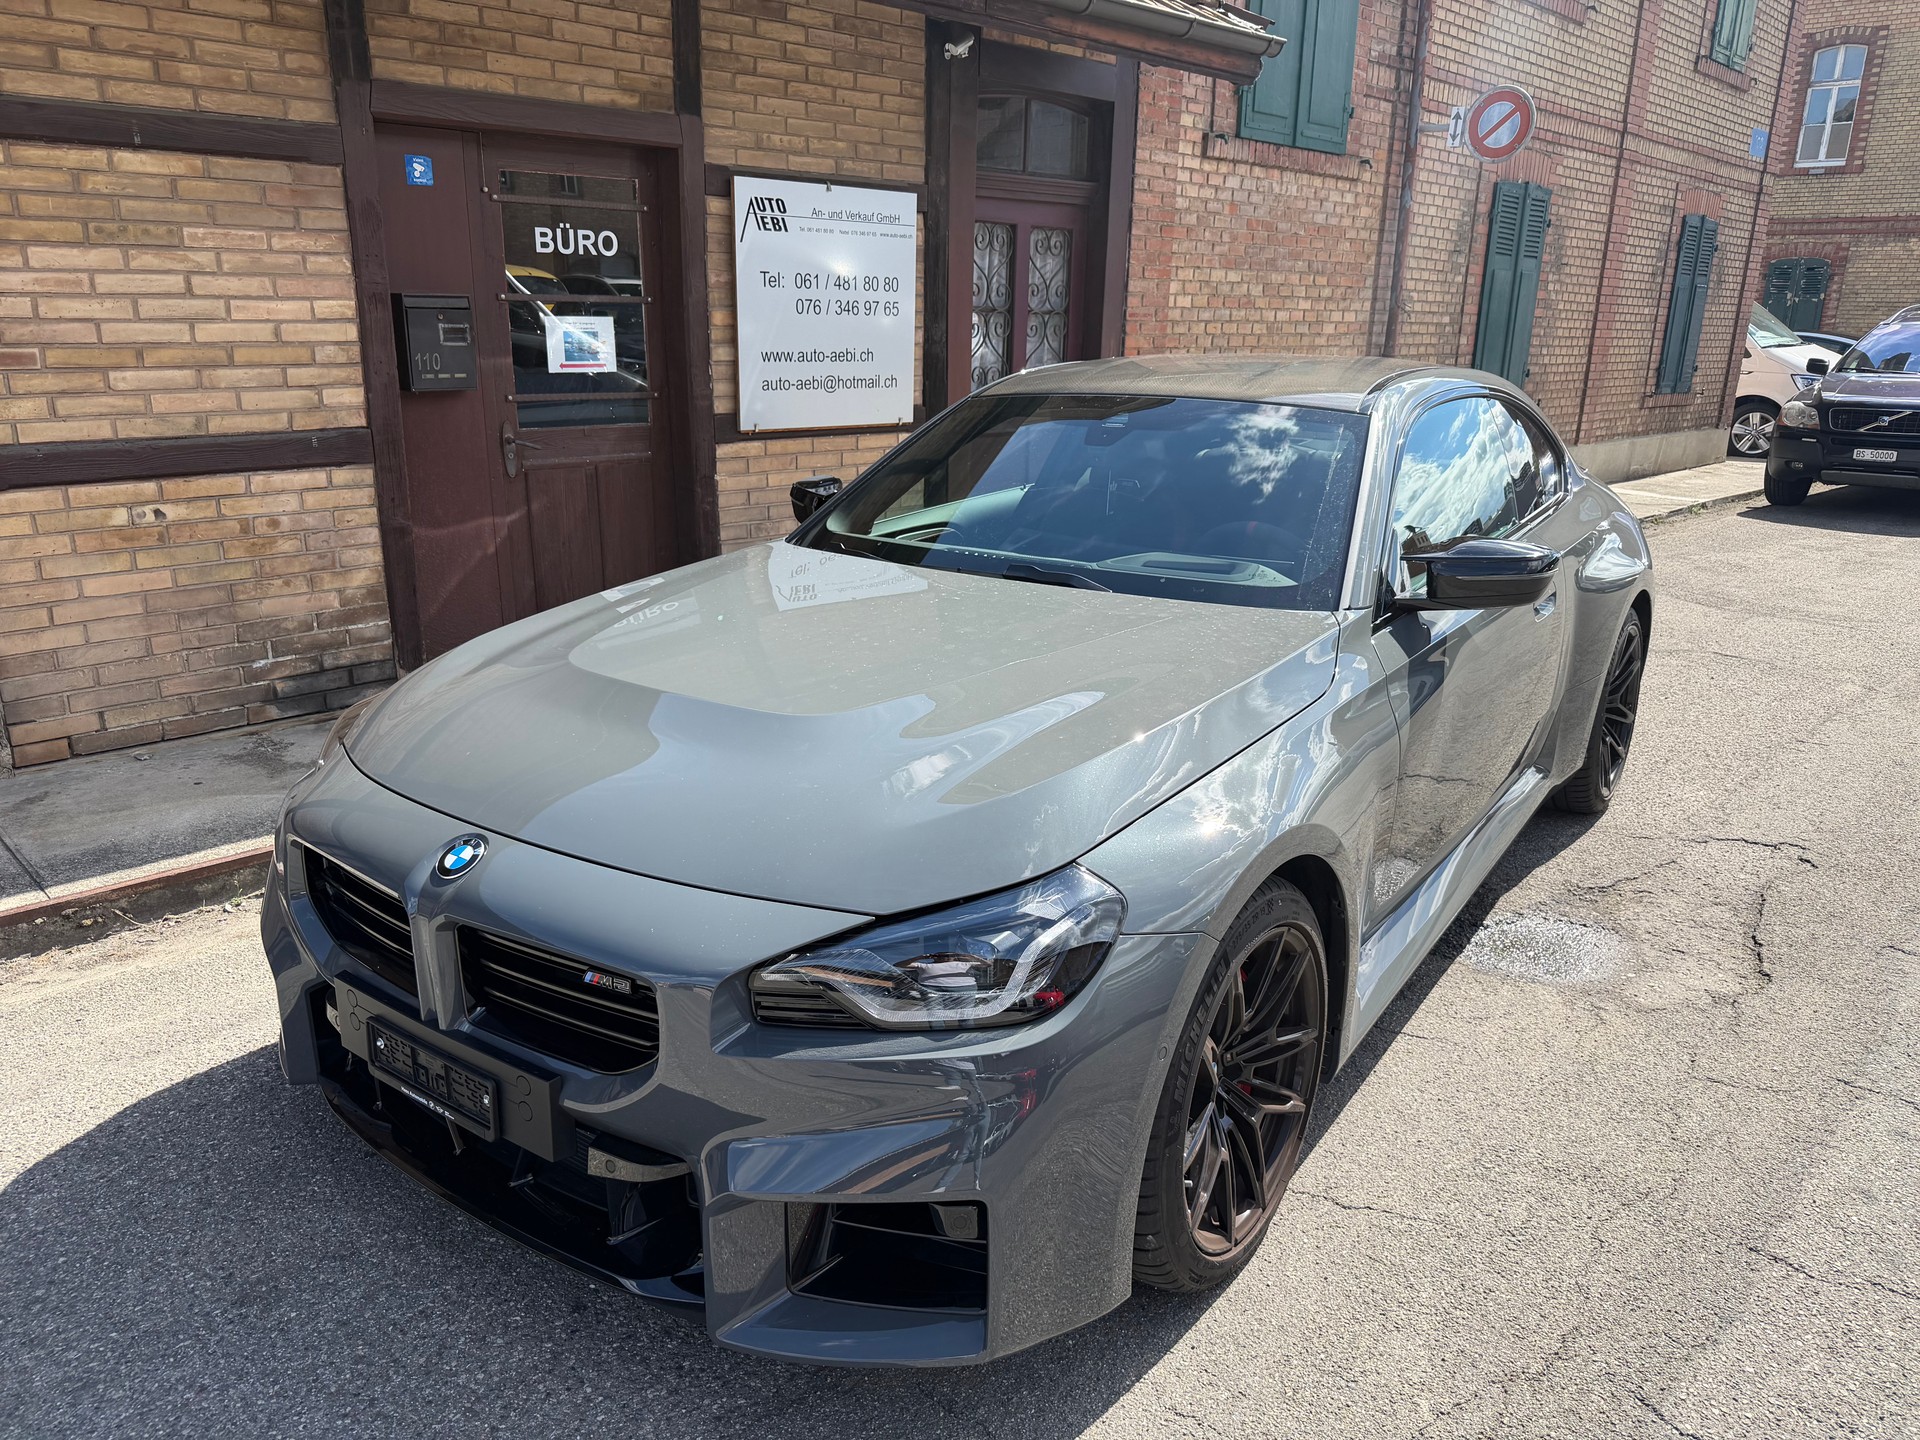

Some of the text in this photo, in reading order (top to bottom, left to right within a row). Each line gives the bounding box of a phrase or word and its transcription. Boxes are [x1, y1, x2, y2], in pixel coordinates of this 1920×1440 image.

[811, 207, 900, 224] An- und Verkauf GmbH
[534, 223, 619, 257] BÜRO
[760, 271, 899, 292] Tel: 061 / 481 80 80
[796, 299, 899, 316] 076 / 346 97 65
[415, 353, 441, 371] 110
[761, 348, 874, 362] www.auto-aebi.ch
[762, 374, 898, 393] auto-aebi@hotmail.ch
[1856, 450, 1894, 460] BS 50000
[1173, 958, 1231, 1103] MICHELIN
